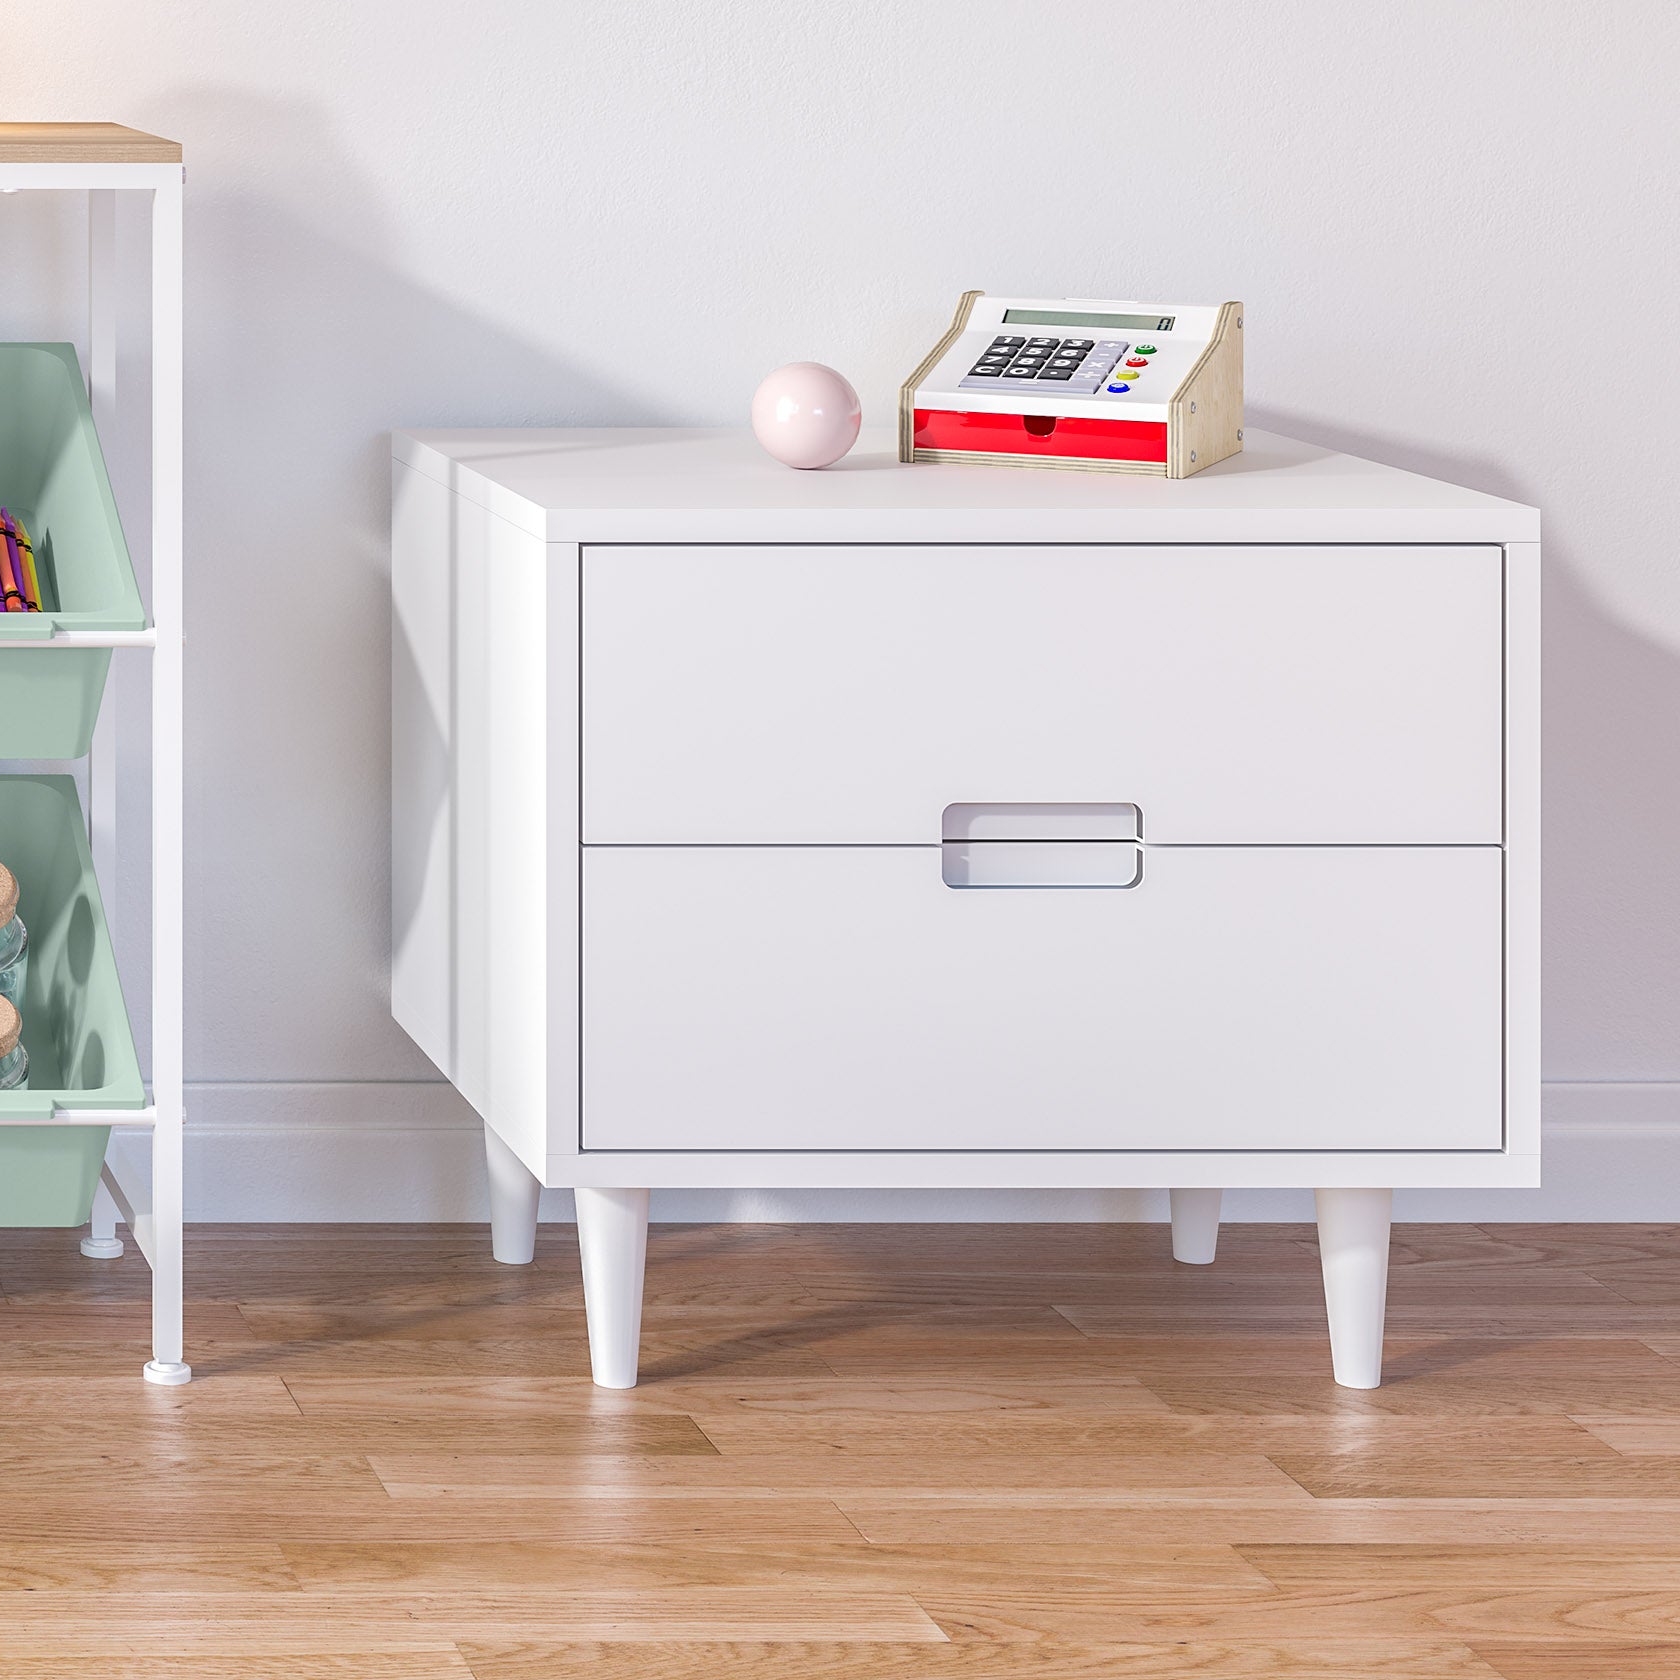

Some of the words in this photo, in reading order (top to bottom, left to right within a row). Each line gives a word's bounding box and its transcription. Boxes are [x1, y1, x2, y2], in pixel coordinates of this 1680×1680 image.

[1157, 318, 1171, 331] 0
[1003, 336, 1015, 344] 1
[1026, 347, 1043, 355] 5
[1060, 349, 1077, 357] 6
[1053, 359, 1070, 367] 9
[975, 366, 995, 374] C
[1009, 367, 1028, 375] 0
